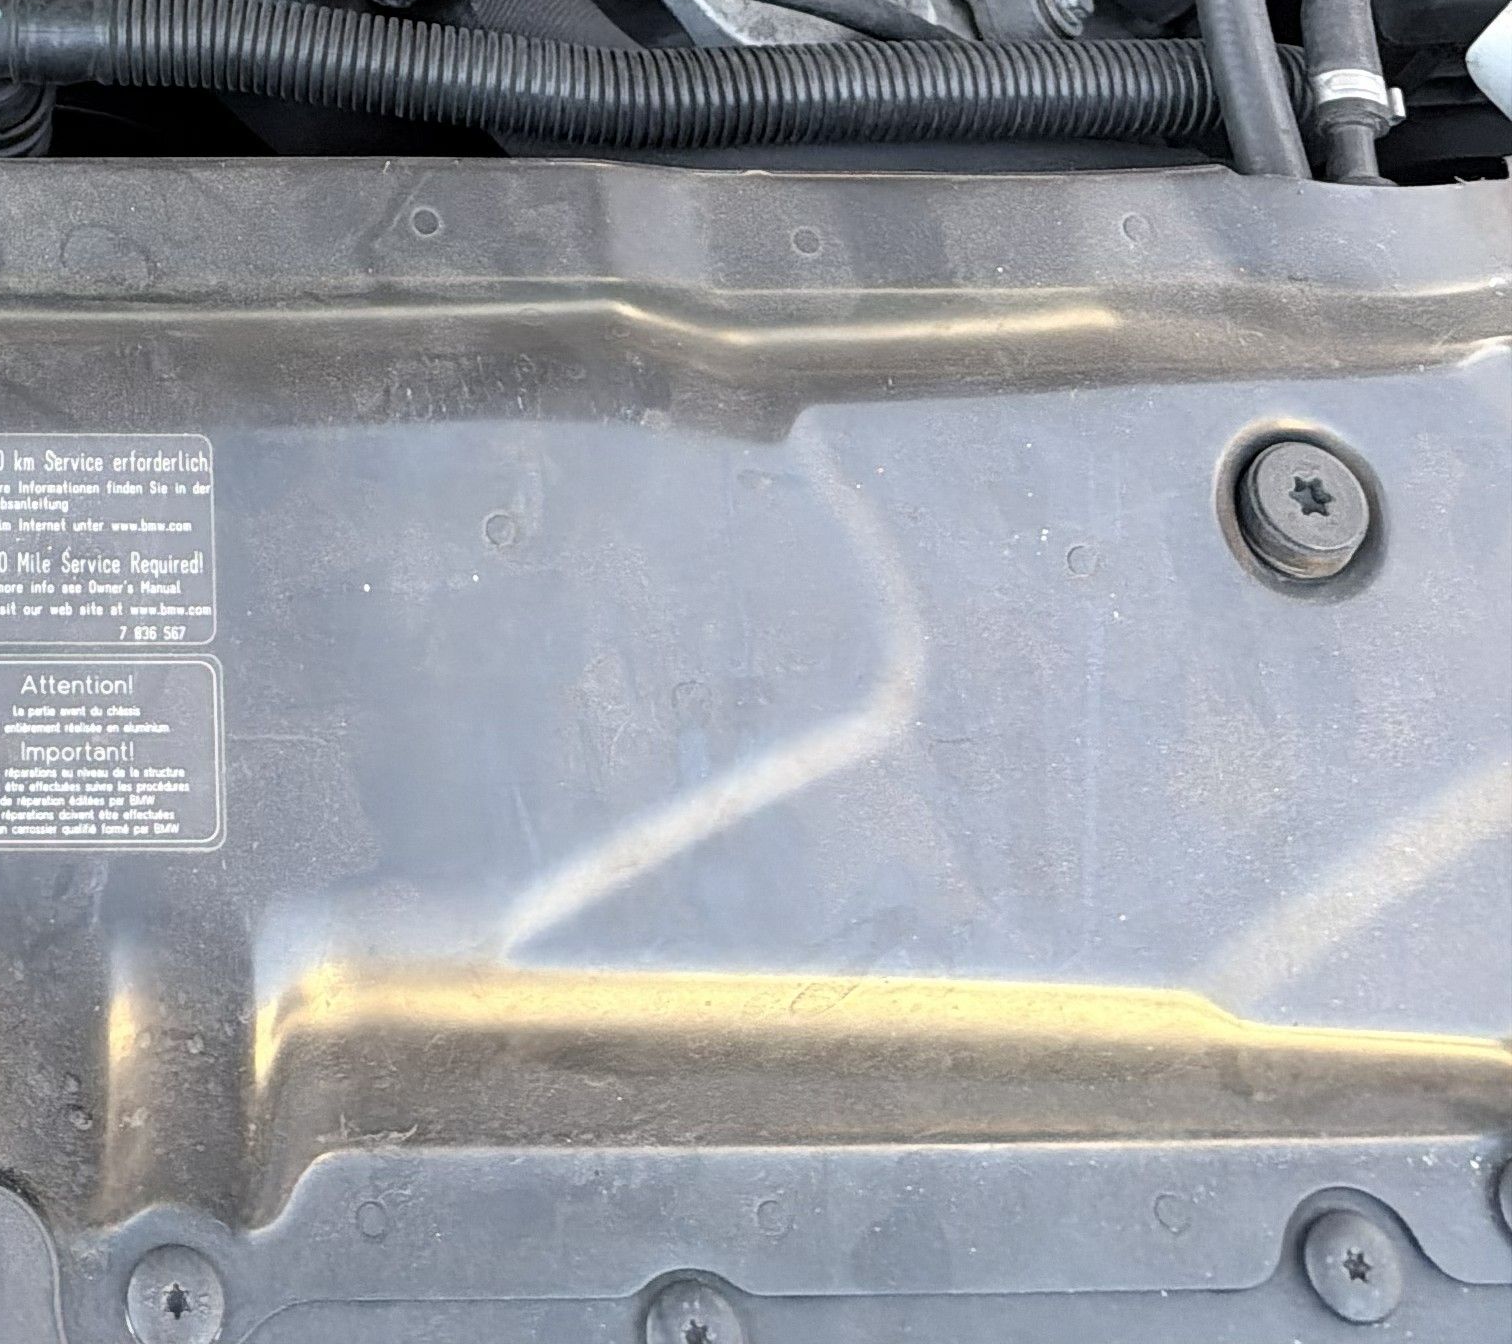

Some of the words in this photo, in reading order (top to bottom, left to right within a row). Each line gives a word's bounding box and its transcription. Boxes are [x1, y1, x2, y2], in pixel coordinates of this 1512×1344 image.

[14, 450, 35, 471] km
[44, 450, 103, 472] Service
[19, 480, 99, 494] Informationen
[107, 481, 142, 494] finden
[150, 481, 168, 494] Sie
[175, 483, 186, 494] in
[193, 481, 211, 494] der
[19, 518, 66, 531] Internet
[73, 518, 104, 532] unter
[111, 518, 192, 532] www.bmw.com
[18, 552, 50, 574] Mile
[61, 550, 120, 574] Service
[131, 551, 203, 578] Required!
[31, 580, 55, 593] info
[62, 583, 82, 594] see
[89, 580, 133, 594] Owner's
[141, 580, 181, 594] Manual
[23, 606, 43, 616] our
[50, 602, 72, 615] web
[80, 602, 103, 615] site
[111, 602, 122, 616] at
[130, 603, 212, 616] www.bmw.com
[120, 626, 127, 640] 7
[164, 626, 186, 640] 567
[21, 675, 133, 694] Attention!
[28, 706, 55, 718] partie
[90, 706, 102, 716] du
[106, 725, 119, 733] en
[21, 741, 133, 764] Important!
[112, 767, 125, 777] de
[0, 795, 12, 806] de
[109, 798, 124, 807] par
[130, 794, 155, 805] BMW
[133, 826, 149, 836] par
[154, 823, 179, 834] BMW
